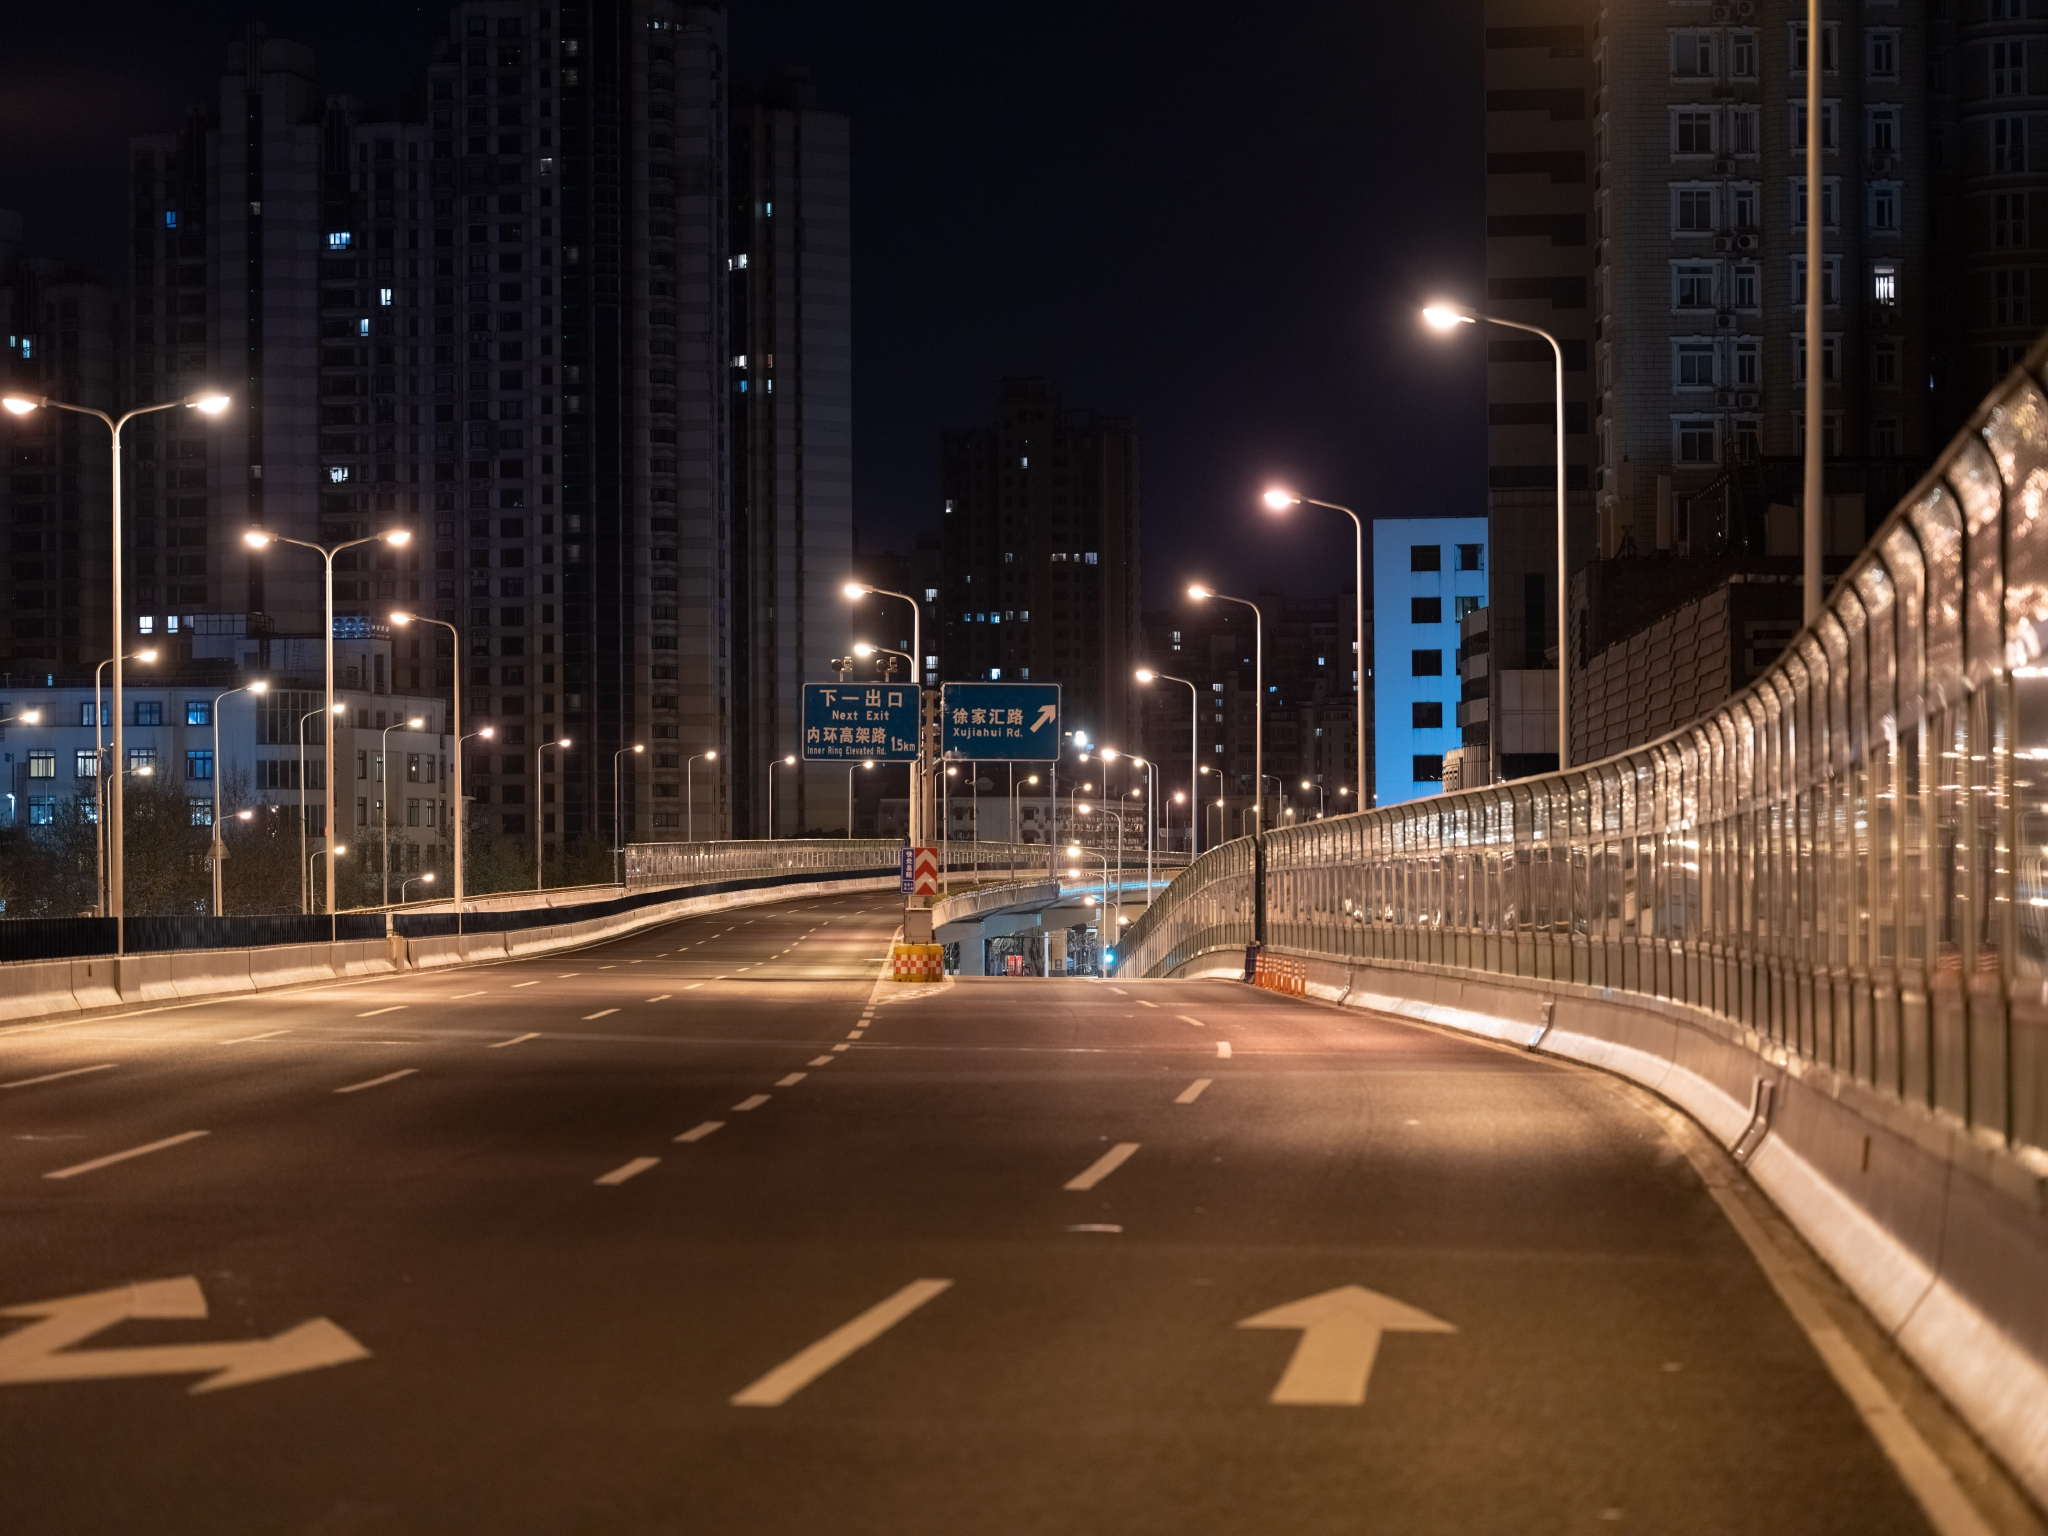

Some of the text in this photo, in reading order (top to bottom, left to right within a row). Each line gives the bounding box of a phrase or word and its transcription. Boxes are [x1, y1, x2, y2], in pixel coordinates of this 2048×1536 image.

[819, 689, 903, 707] 下一出口
[832, 710, 889, 720] Next Exit
[952, 708, 1024, 725] 徐家汇路
[807, 726, 887, 744] 内环高架路
[953, 727, 1023, 739] Xujiahui Rd.
[807, 746, 887, 757] Inner Ring Elevated Rd.
